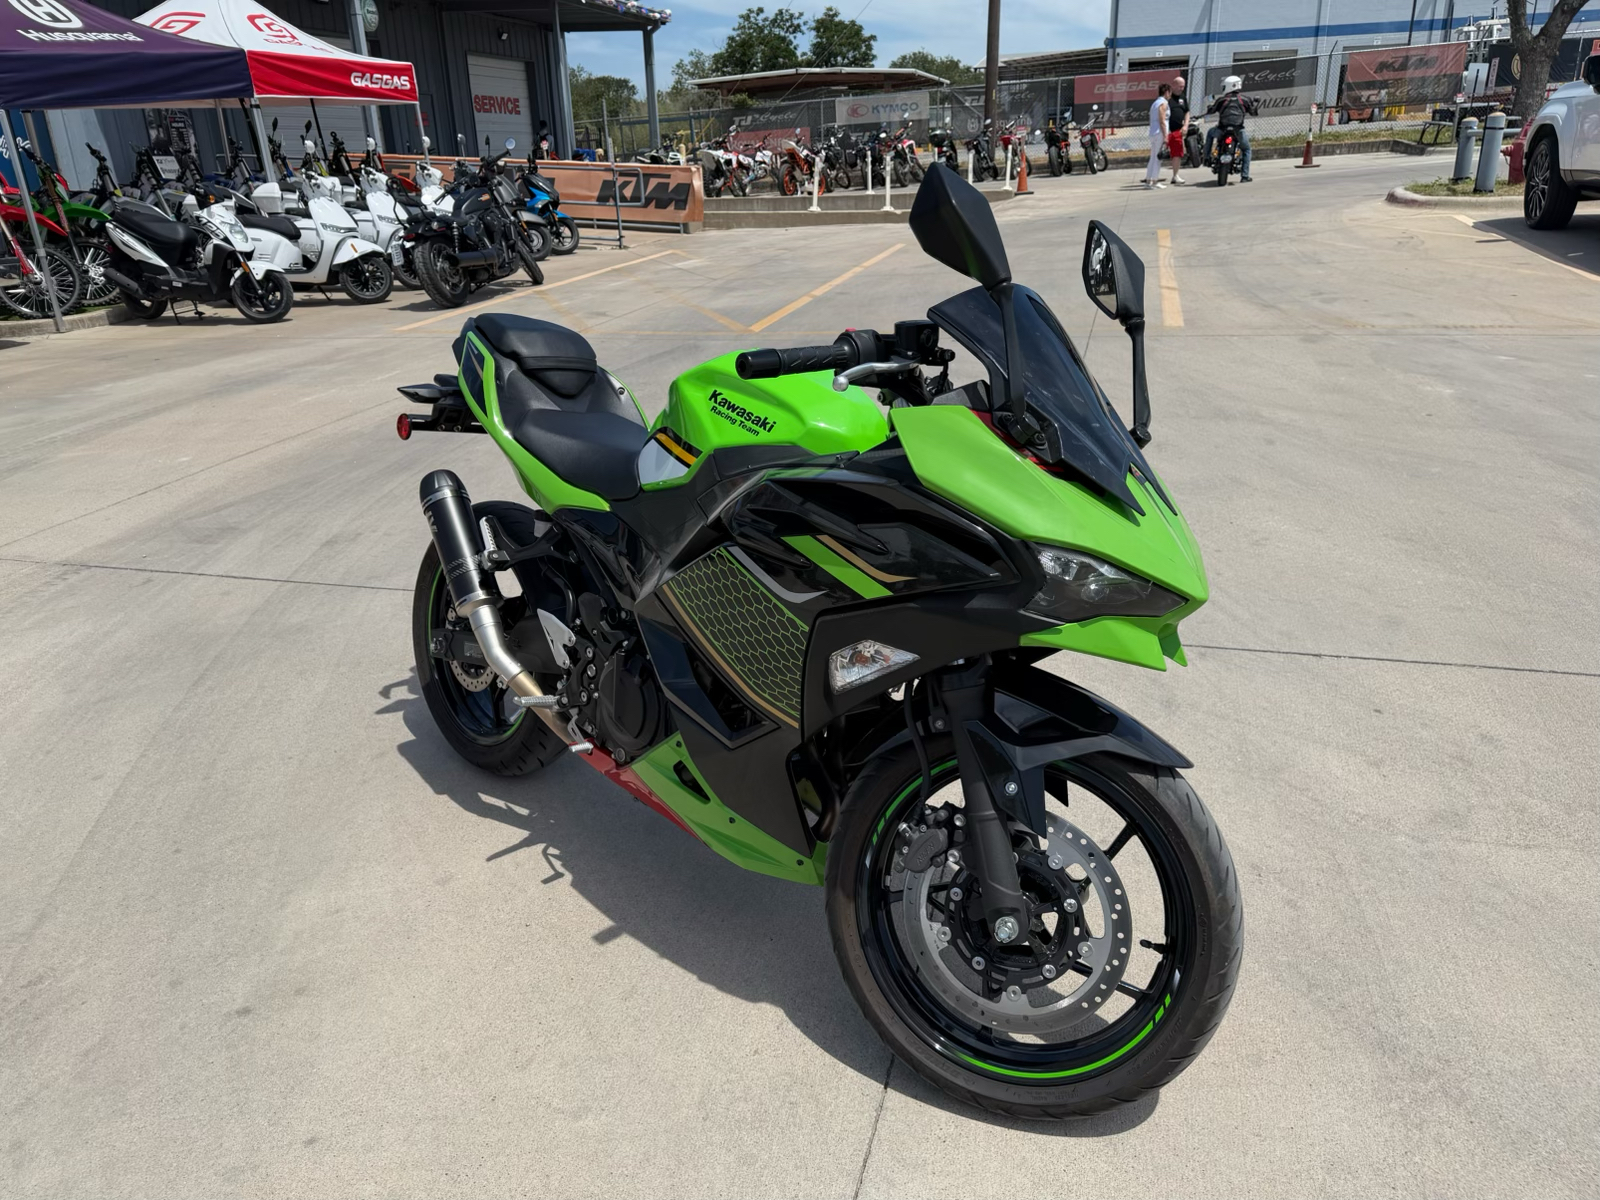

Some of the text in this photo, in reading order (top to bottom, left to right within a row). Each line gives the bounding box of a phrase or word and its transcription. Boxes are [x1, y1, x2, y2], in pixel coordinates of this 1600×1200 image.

[351, 72, 411, 90] GASGAS
[1094, 80, 1160, 94] GASGAS
[473, 94, 521, 116] SERVICE
[872, 102, 919, 114] KYMCO
[1118, 108, 1151, 119] Cyc
[596, 172, 691, 211] KTM
[708, 389, 777, 433] Kawasaki
[710, 405, 760, 437] Racing Team
